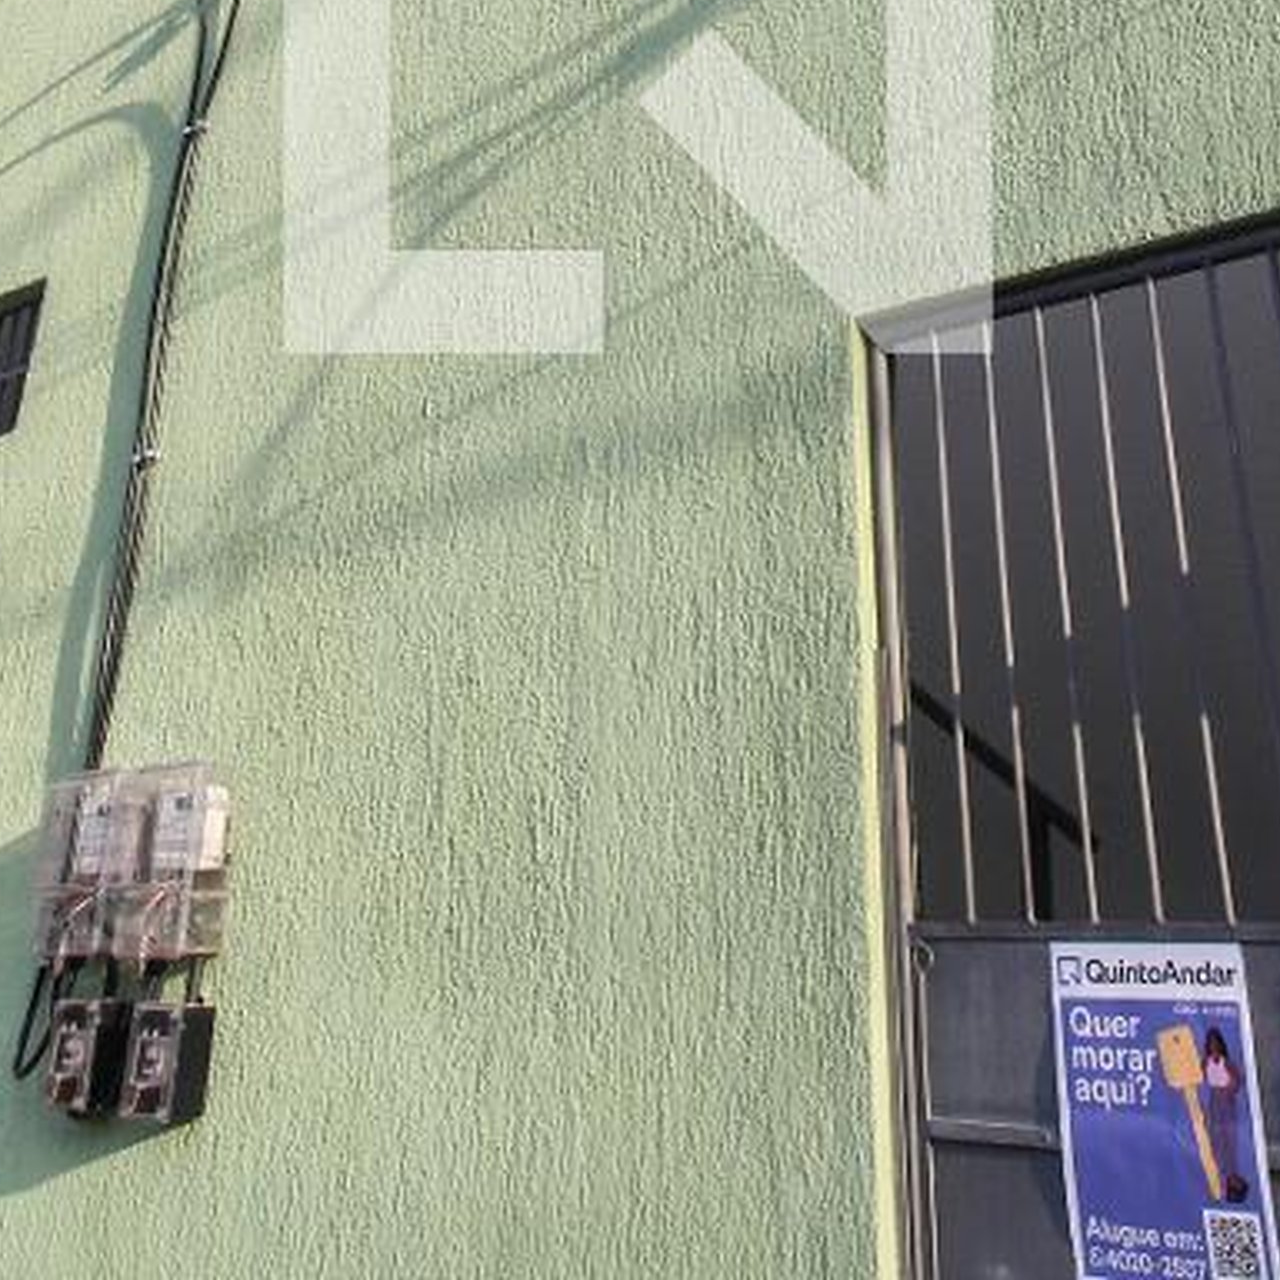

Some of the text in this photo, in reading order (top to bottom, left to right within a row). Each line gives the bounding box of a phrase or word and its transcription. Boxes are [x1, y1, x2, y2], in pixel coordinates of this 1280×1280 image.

[1086, 959, 1236, 987] QuintoAndar
[1070, 1006, 1140, 1038] Quer
[1072, 1044, 1156, 1071] morar
[1075, 1074, 1152, 1109] aqui?
[1086, 1215, 1160, 1248] Alugue
